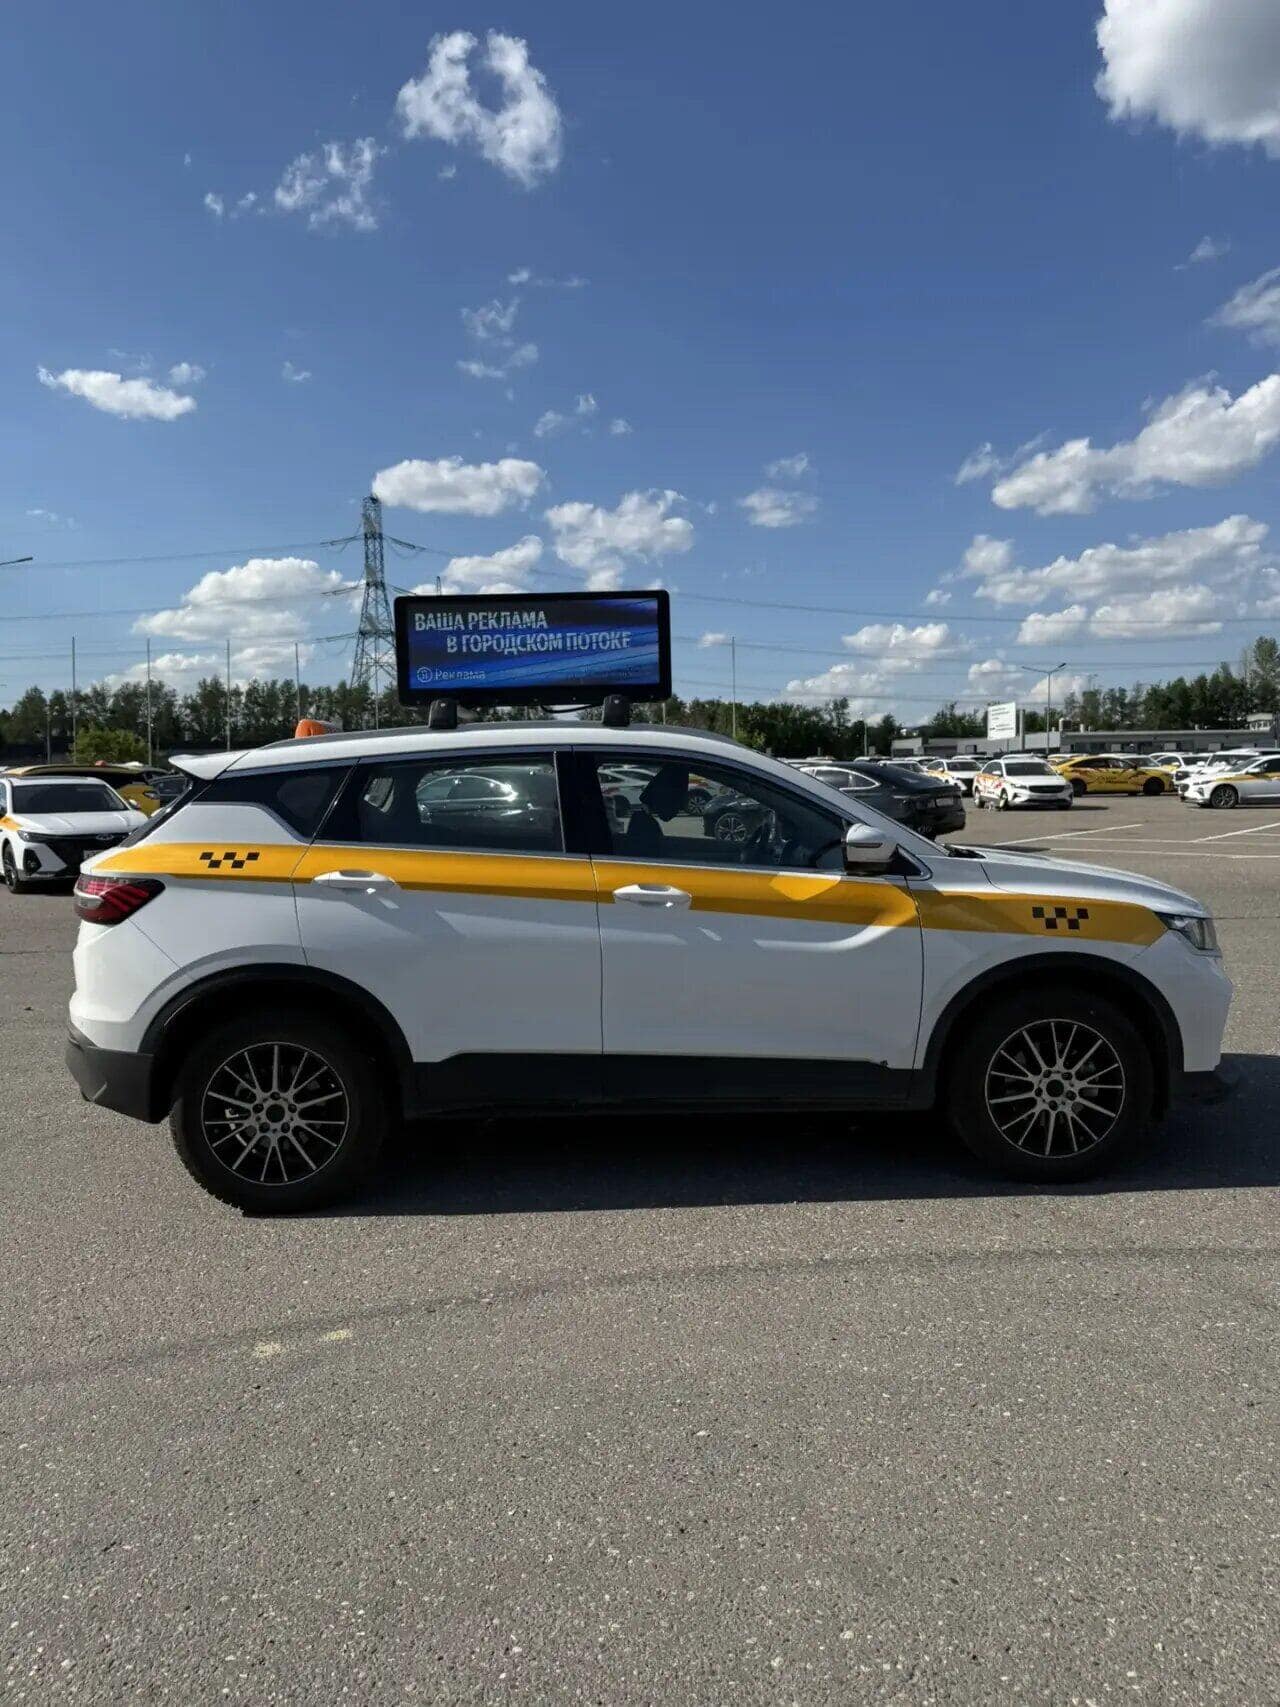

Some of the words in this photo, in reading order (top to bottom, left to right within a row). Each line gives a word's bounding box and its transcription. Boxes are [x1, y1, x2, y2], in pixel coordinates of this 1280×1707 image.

[414, 613, 465, 631] ВАША
[468, 611, 548, 630] РЕКЛАМА
[447, 635, 457, 653] В
[462, 632, 562, 655] ГОРОДСКОМ
[566, 631, 631, 650] ПОТОКЕ
